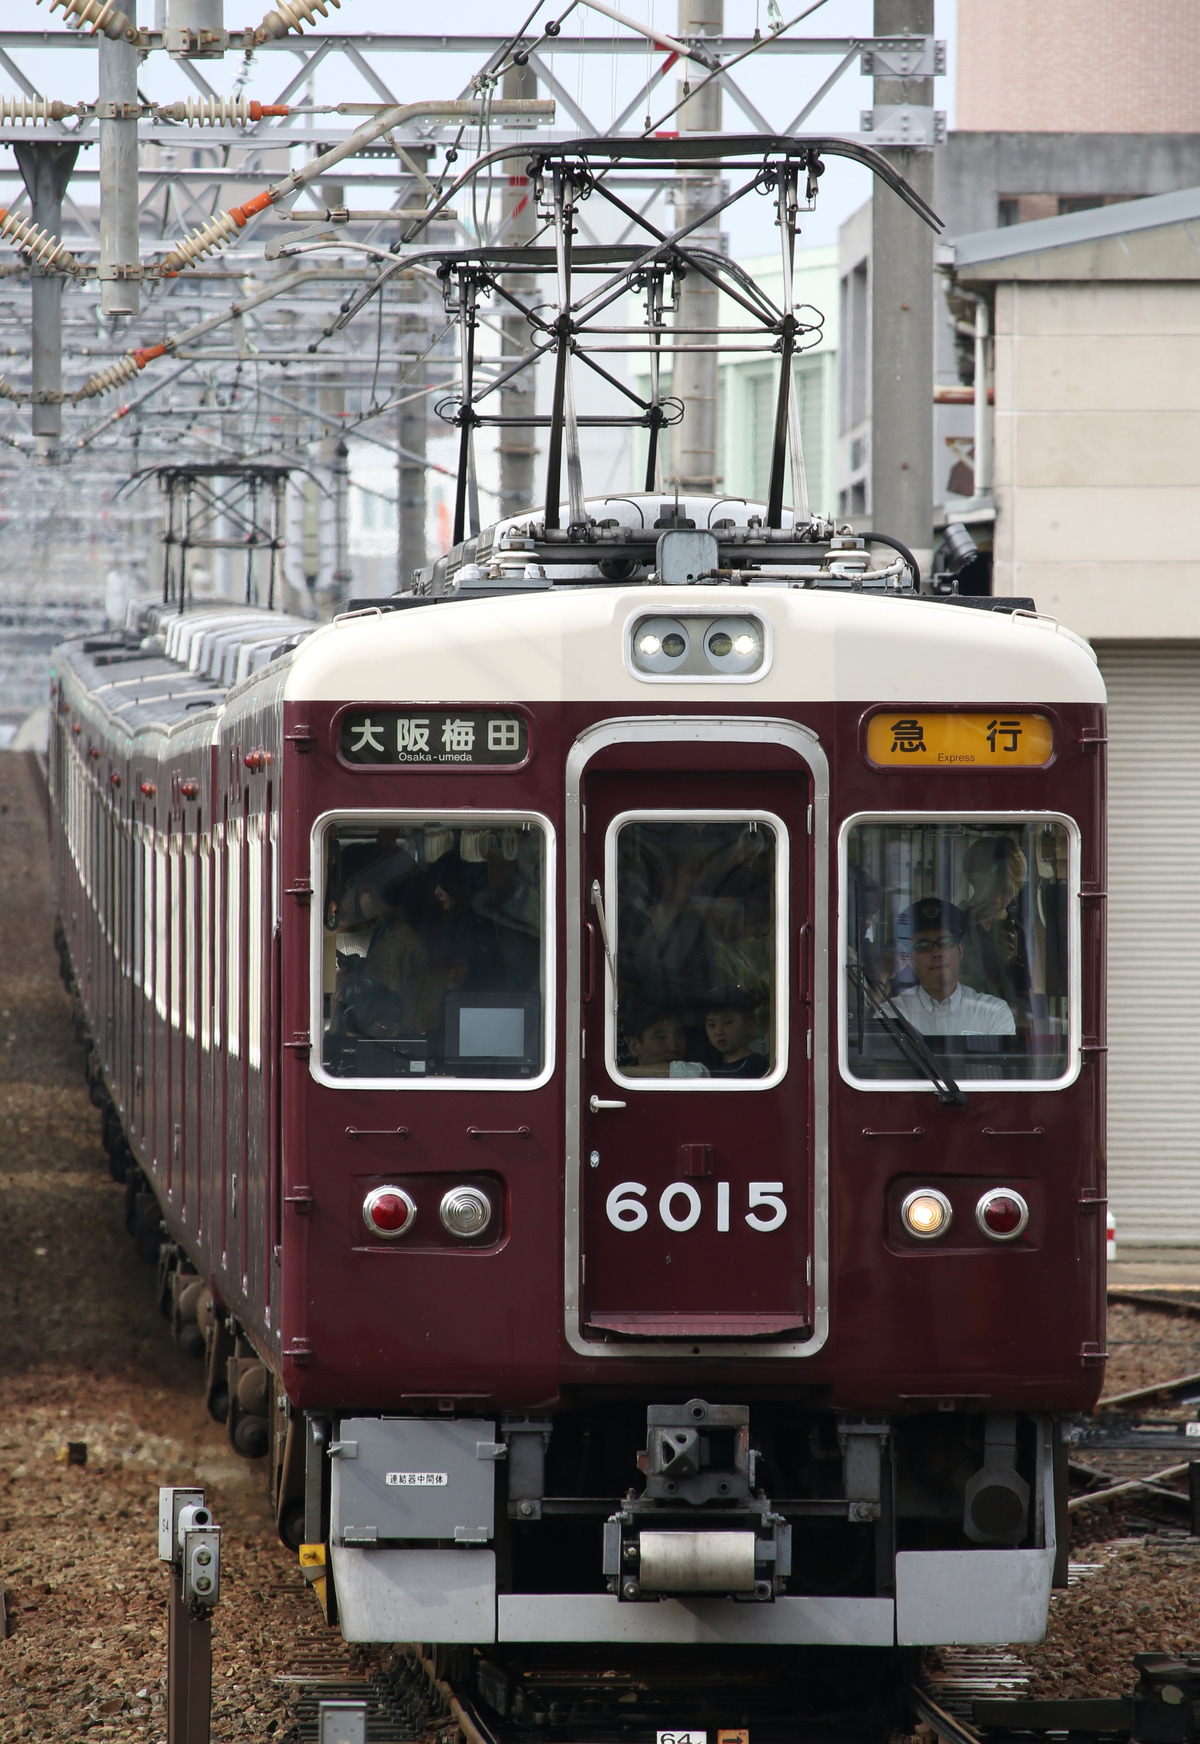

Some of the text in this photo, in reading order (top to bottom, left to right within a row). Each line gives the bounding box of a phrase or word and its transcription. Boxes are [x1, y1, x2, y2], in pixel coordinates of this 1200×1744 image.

[351, 718, 520, 752] 大阪梅田
[890, 719, 1023, 752] 急行
[398, 752, 472, 762] Osaka-umeda
[938, 752, 975, 763] Express
[605, 1181, 788, 1233] 6015
